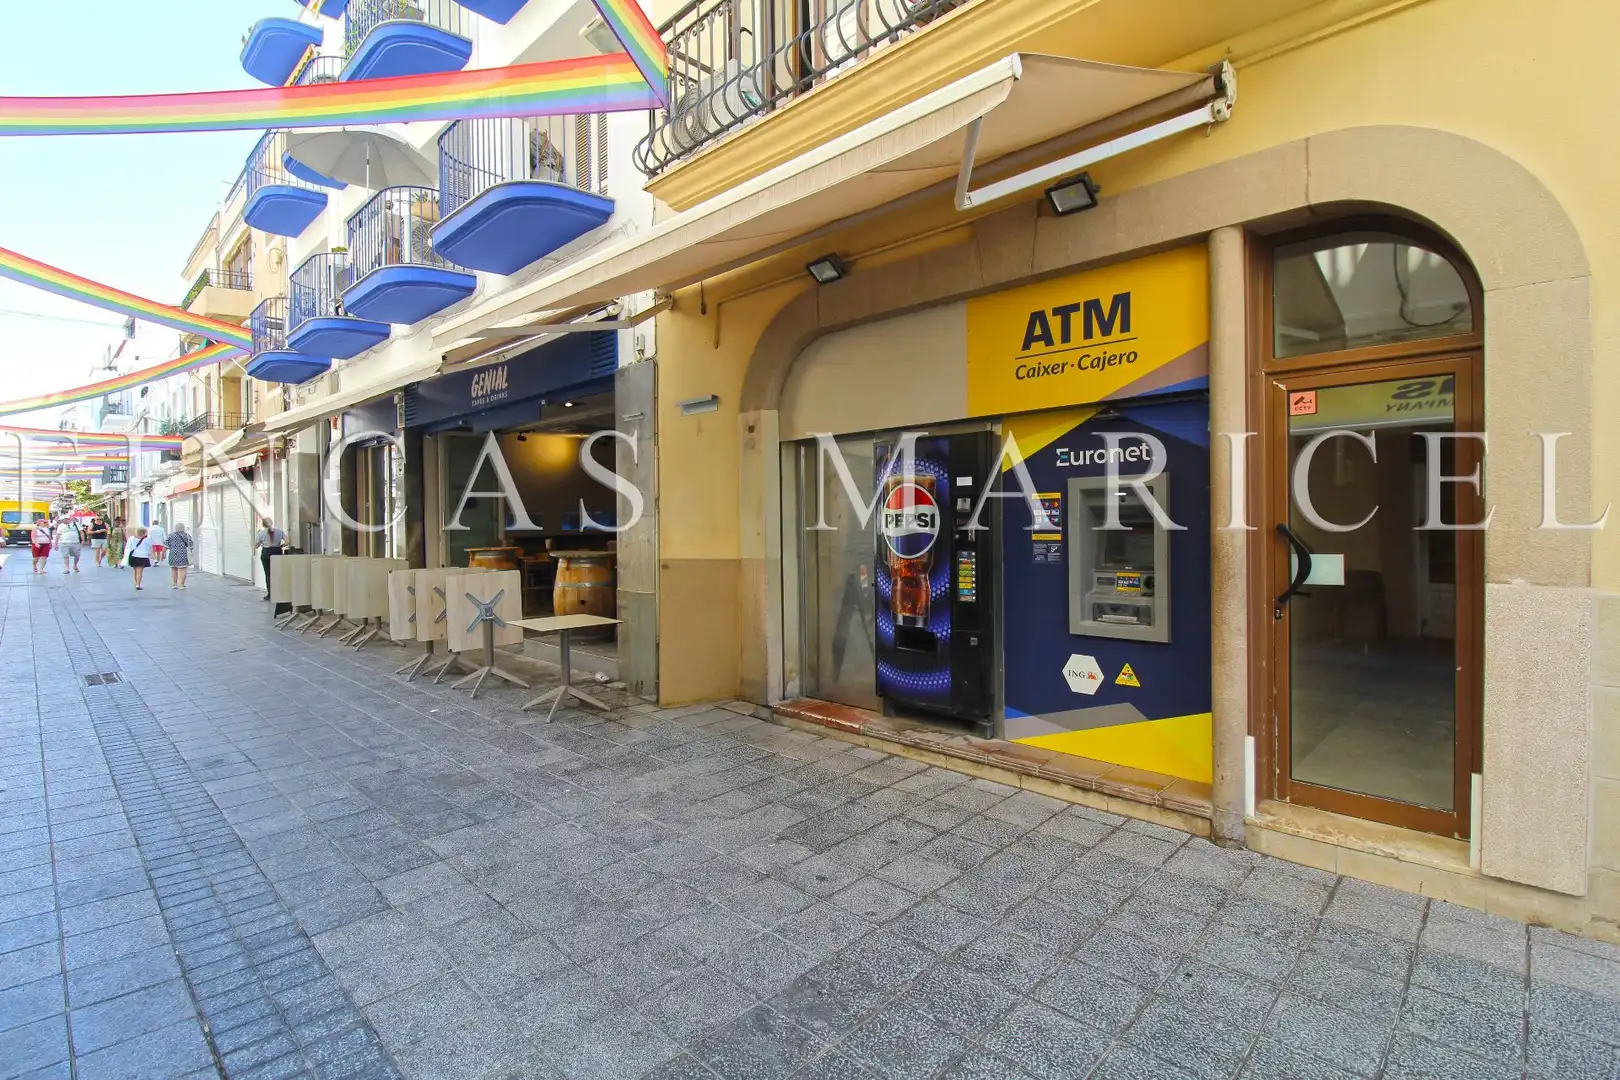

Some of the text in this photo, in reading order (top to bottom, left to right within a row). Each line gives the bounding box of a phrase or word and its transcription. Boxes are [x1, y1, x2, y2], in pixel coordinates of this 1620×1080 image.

[1021, 291, 1131, 351] ATM
[1015, 350, 1138, 380] Caixer Cajero
[471, 365, 508, 398] GENIAL
[1056, 443, 1151, 467] Euronet
[885, 512, 936, 529] PEPSI
[1067, 669, 1086, 680] ING
